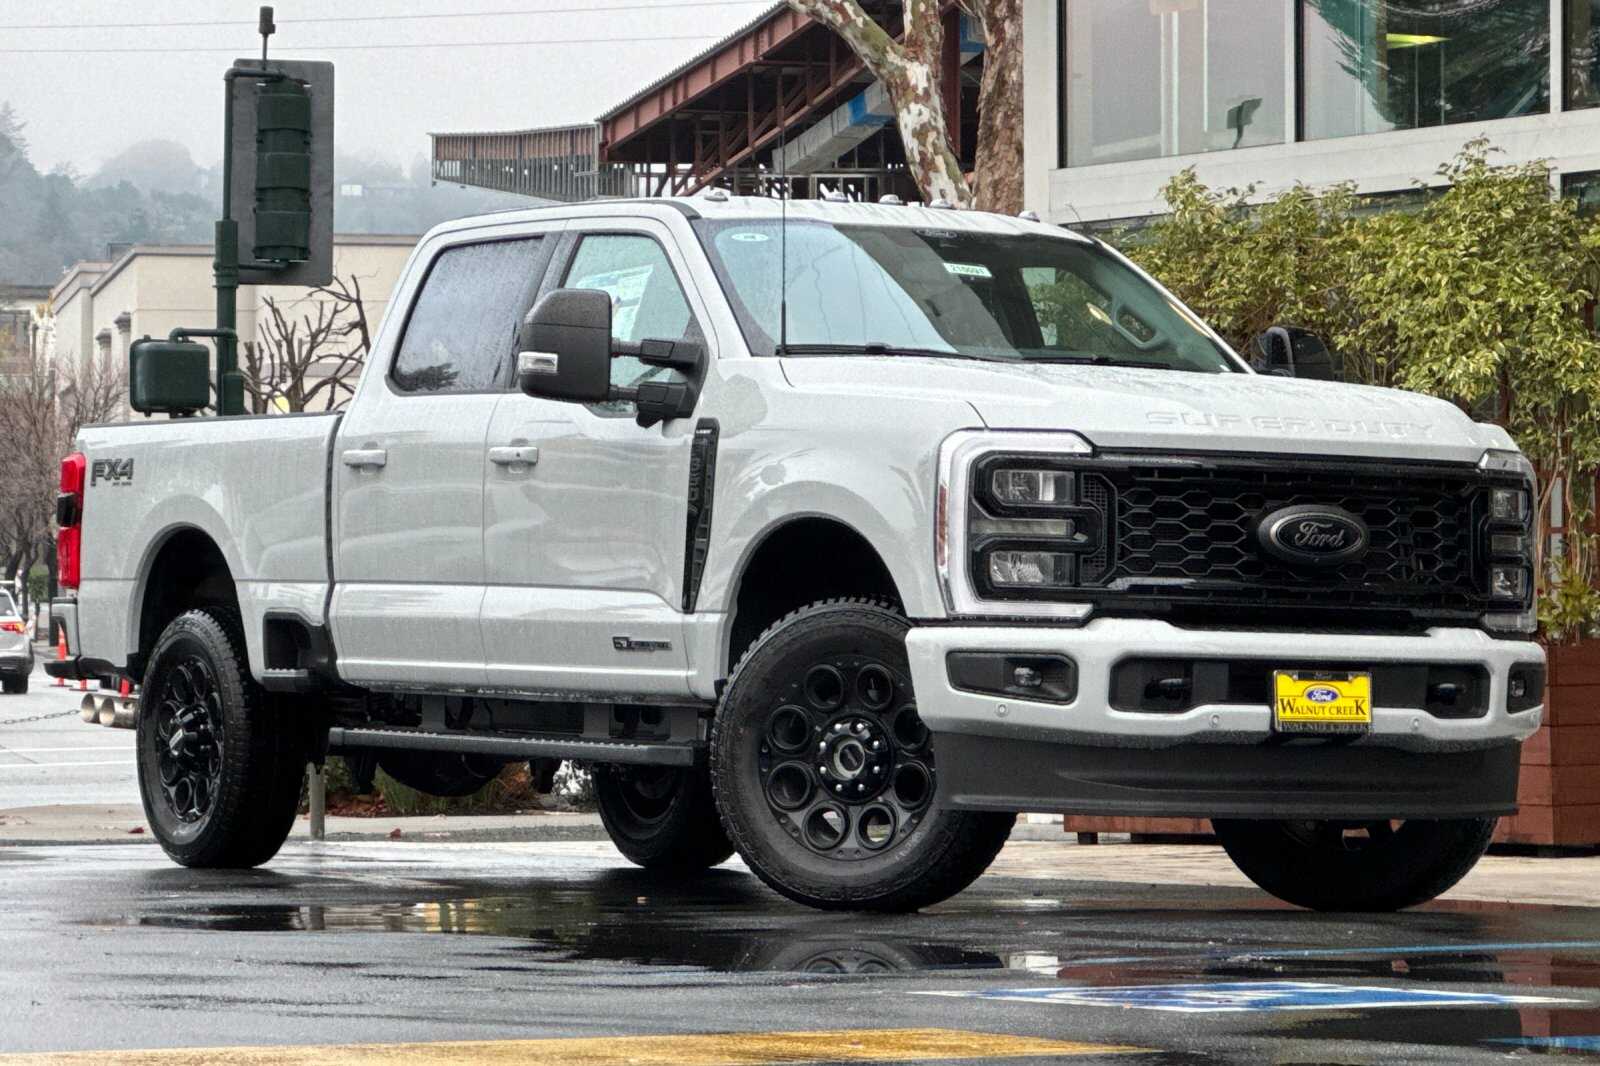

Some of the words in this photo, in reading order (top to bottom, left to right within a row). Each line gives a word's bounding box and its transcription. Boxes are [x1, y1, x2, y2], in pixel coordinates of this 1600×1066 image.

[1145, 410, 1315, 433] SUPER
[1324, 417, 1434, 438] DUTY
[90, 457, 134, 487] FX4
[1294, 521, 1345, 547] Ford
[1279, 698, 1326, 715] WALNUT
[1328, 698, 1367, 716] CREEK
[1311, 689, 1334, 702] Ford
